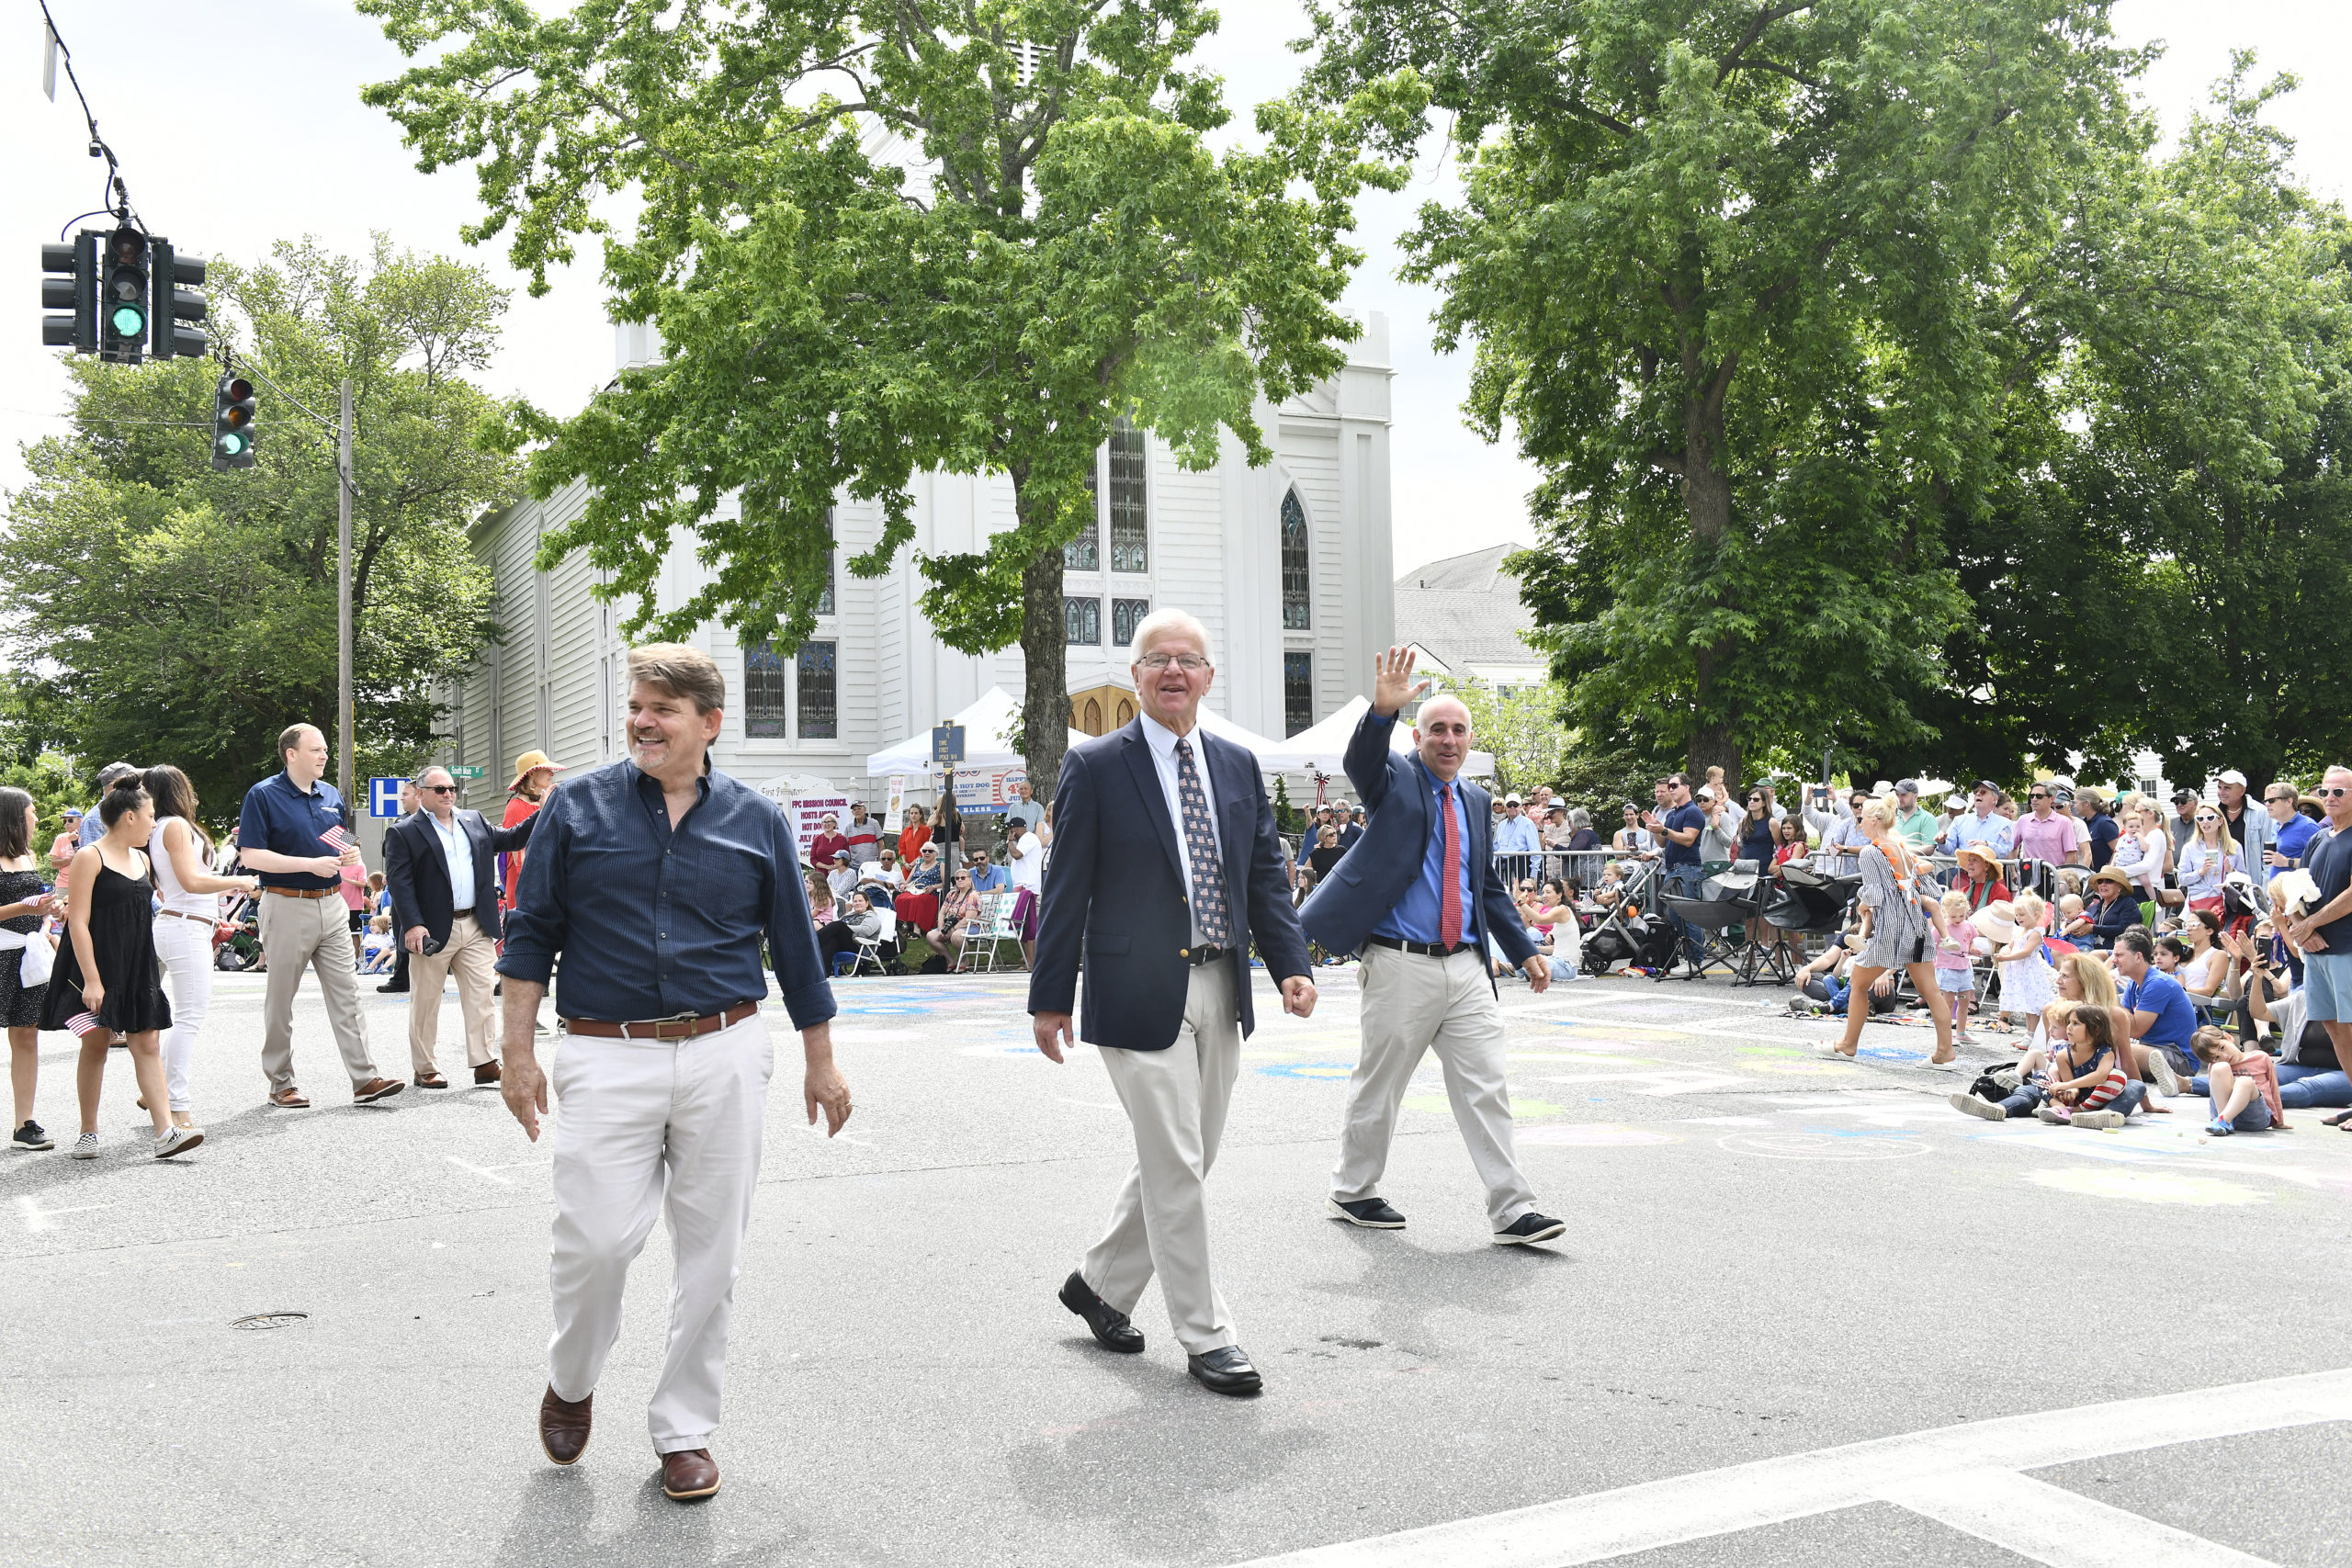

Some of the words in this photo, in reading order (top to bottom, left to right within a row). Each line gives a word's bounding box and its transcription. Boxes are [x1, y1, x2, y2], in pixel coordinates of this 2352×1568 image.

[451, 765, 462, 774] South
[463, 766, 472, 775] Main
[376, 780, 405, 816] H
[792, 800, 802, 809] FPC
[803, 799, 824, 808] MISSION
[825, 798, 847, 807] COUNCIL
[800, 811, 818, 820] HOSTS
[801, 823, 813, 831] HOT
[798, 834, 811, 842] JULY
